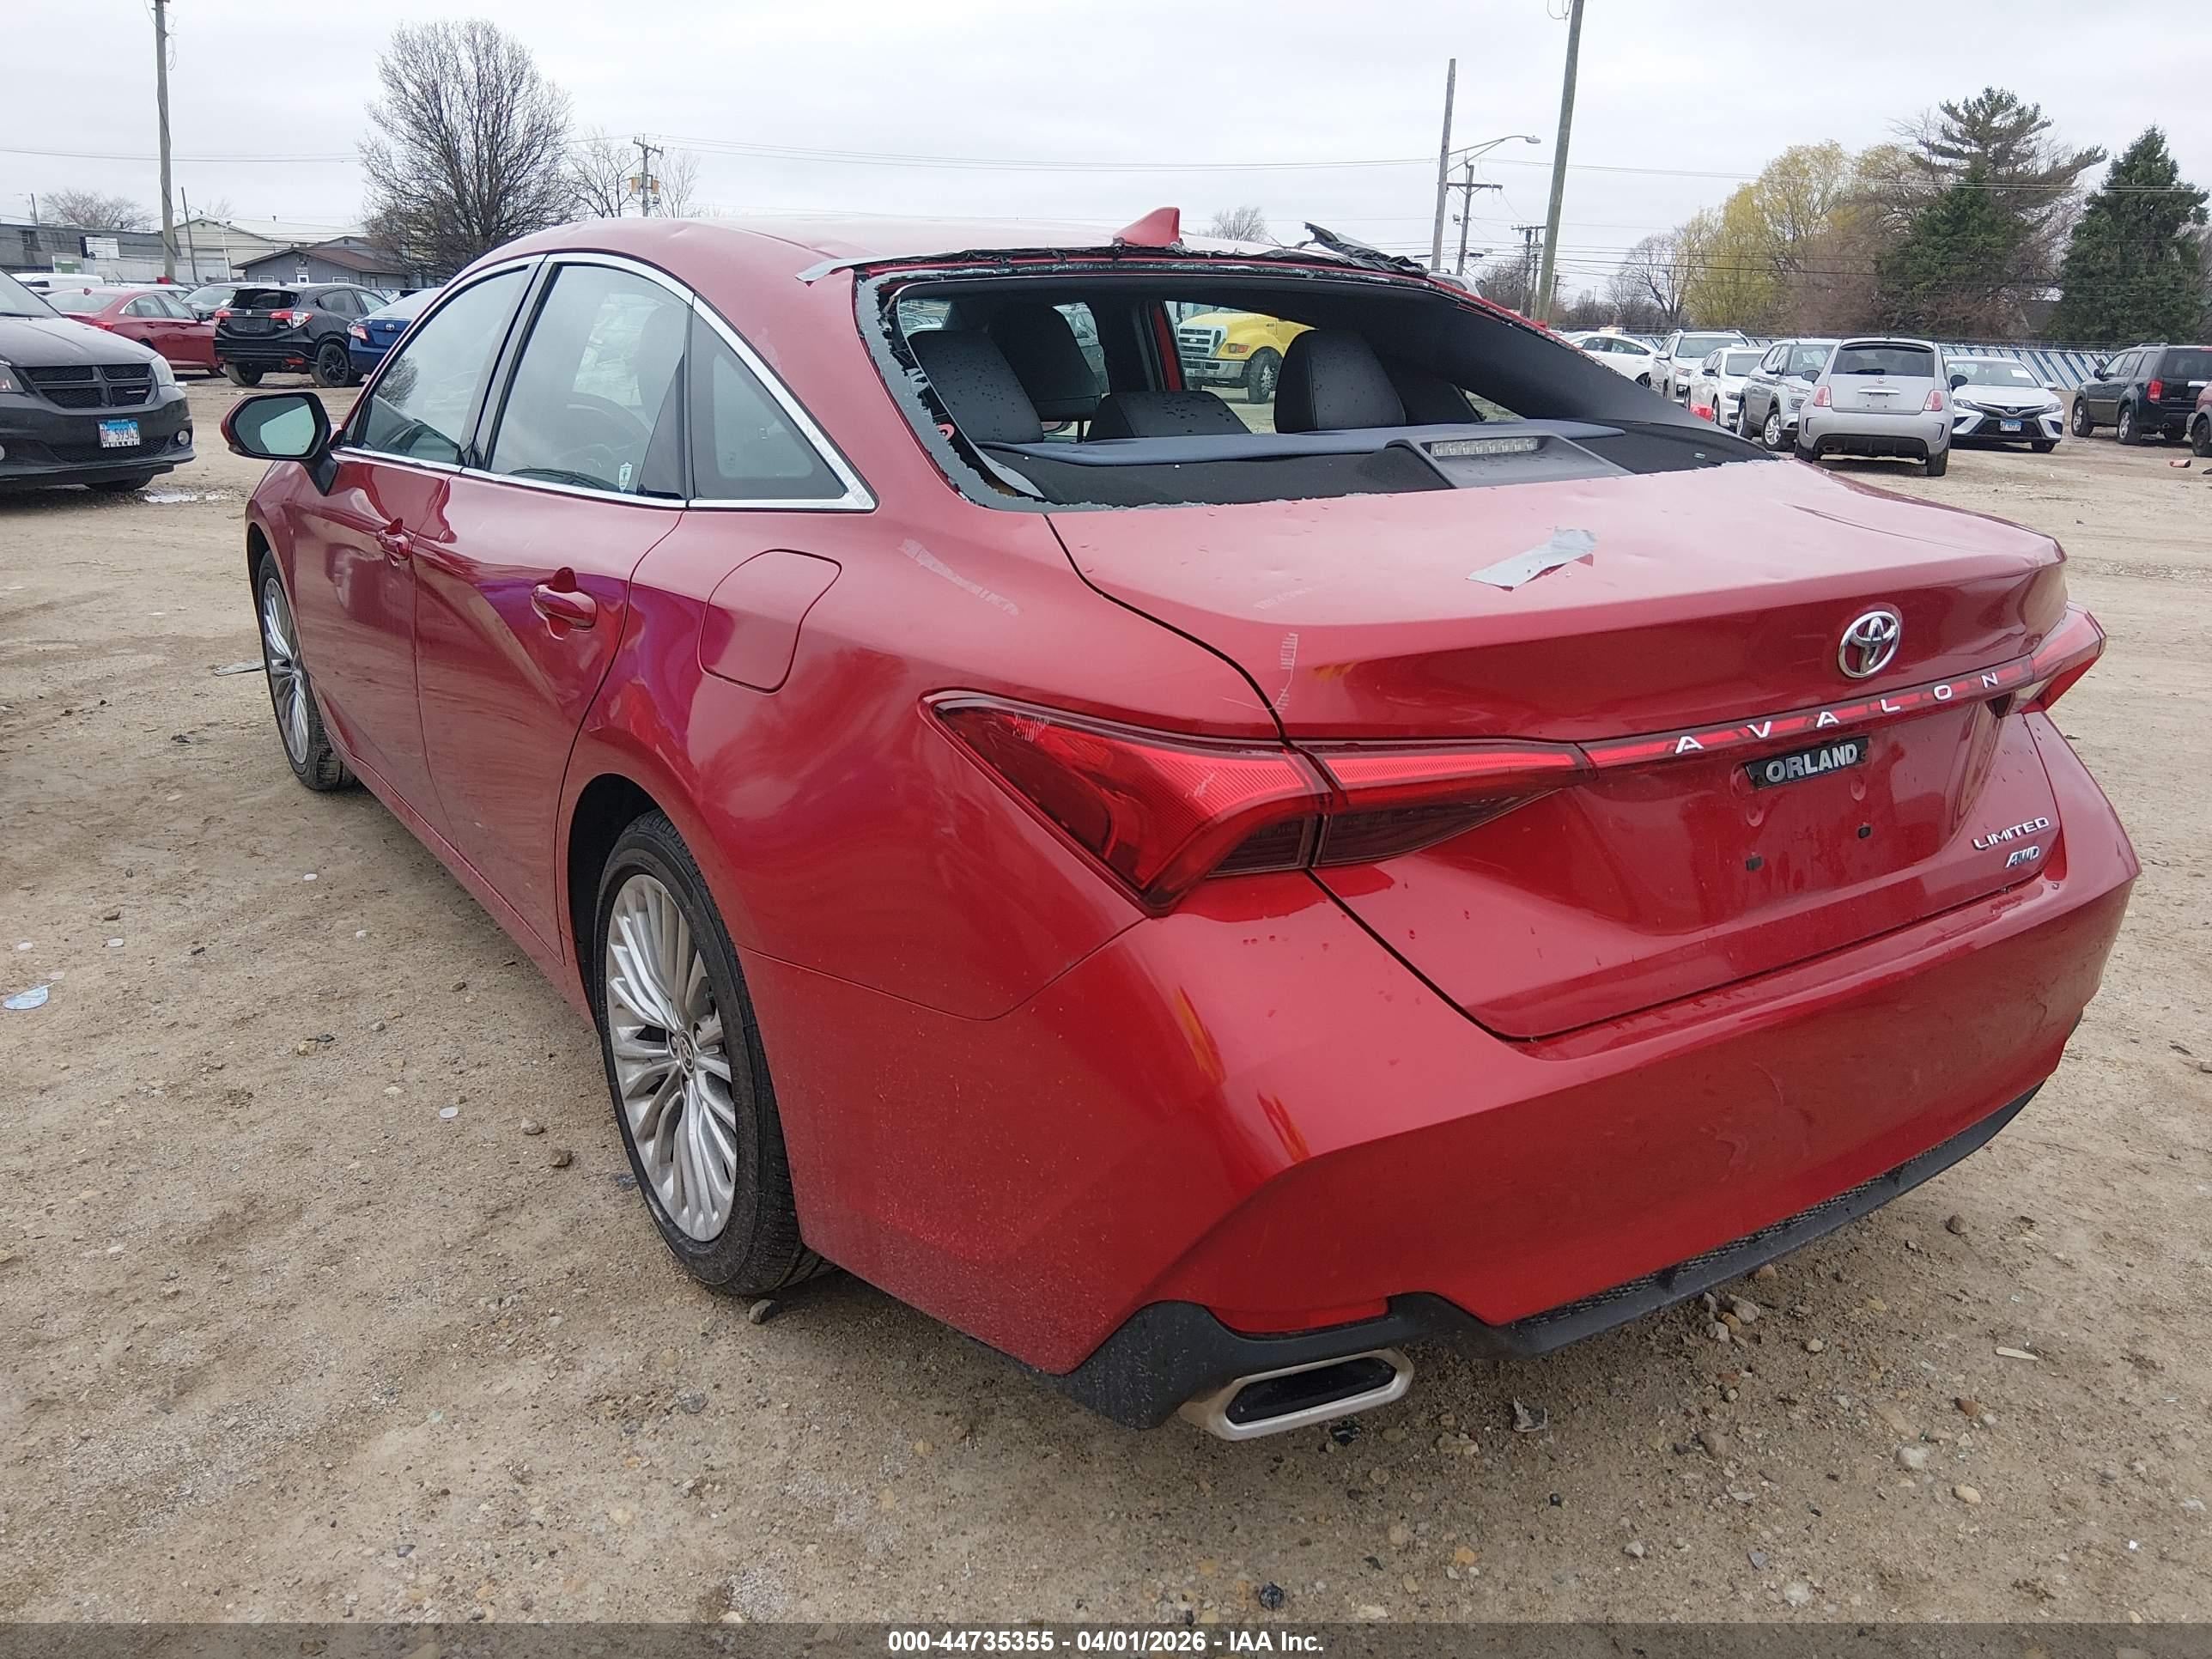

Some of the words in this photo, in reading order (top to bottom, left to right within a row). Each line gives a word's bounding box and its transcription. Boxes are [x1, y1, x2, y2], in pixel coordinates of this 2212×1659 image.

[1674, 672, 2000, 755] AVALON
[1765, 743, 1858, 783] ORLAND
[1972, 817, 2051, 850] LIMITED
[2005, 845, 2040, 869] AWD
